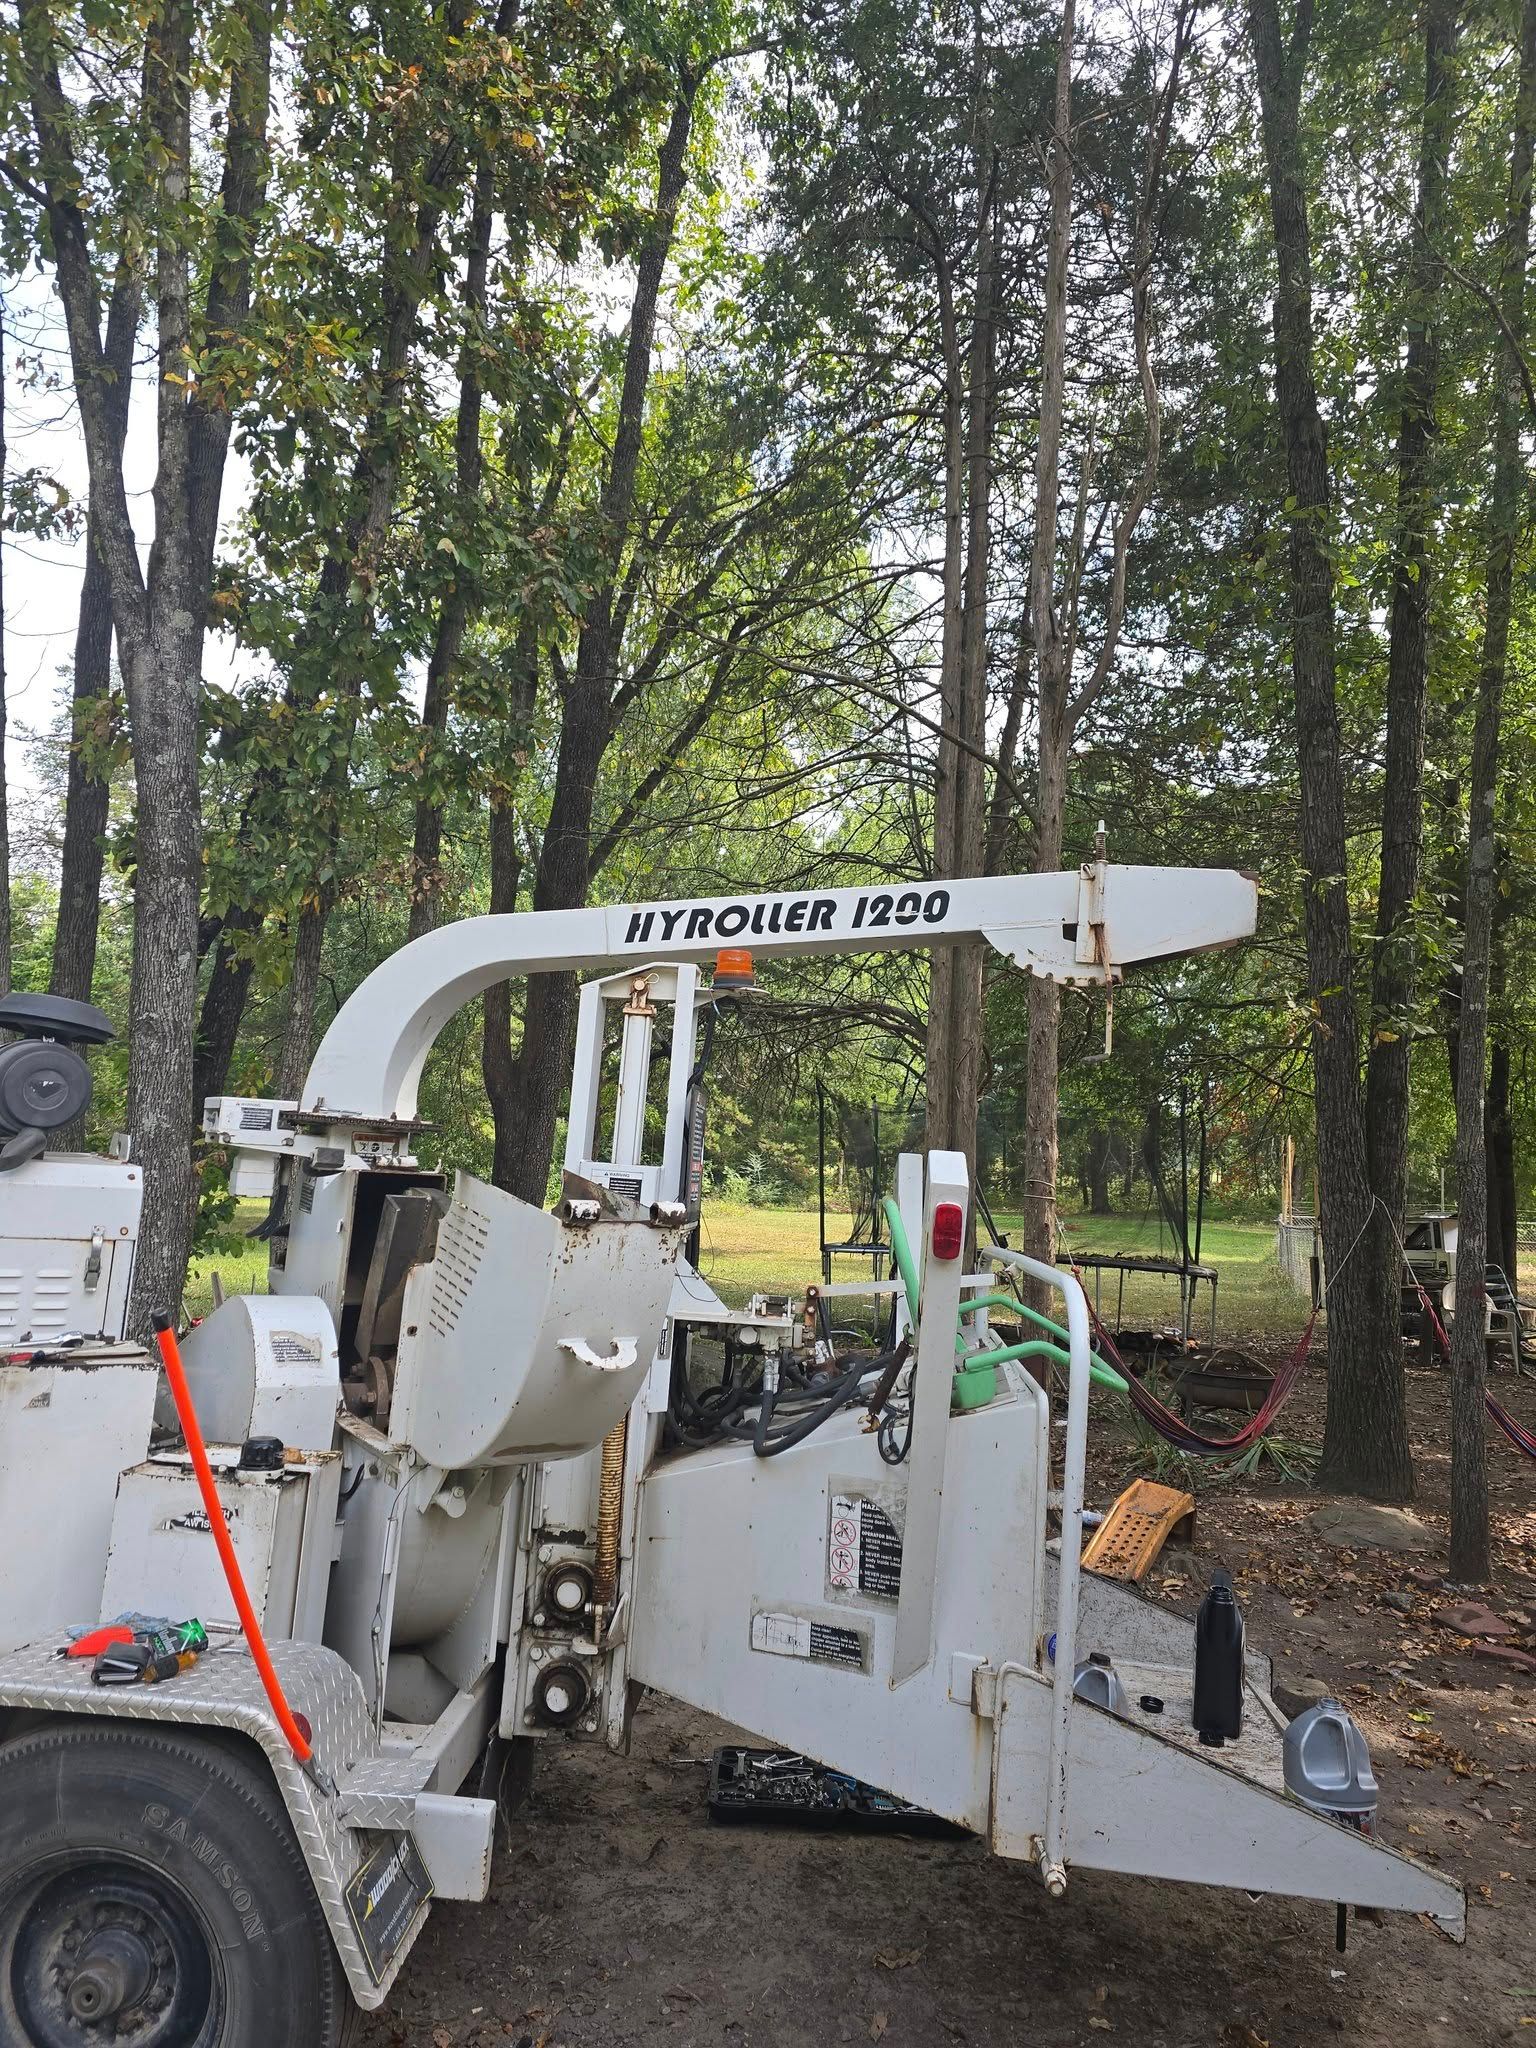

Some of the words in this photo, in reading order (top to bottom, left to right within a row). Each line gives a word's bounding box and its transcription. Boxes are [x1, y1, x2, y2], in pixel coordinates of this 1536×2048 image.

[624, 900, 838, 943] HYROLLER
[852, 890, 950, 928] 1200
[141, 1802, 267, 1941] SAMSON
